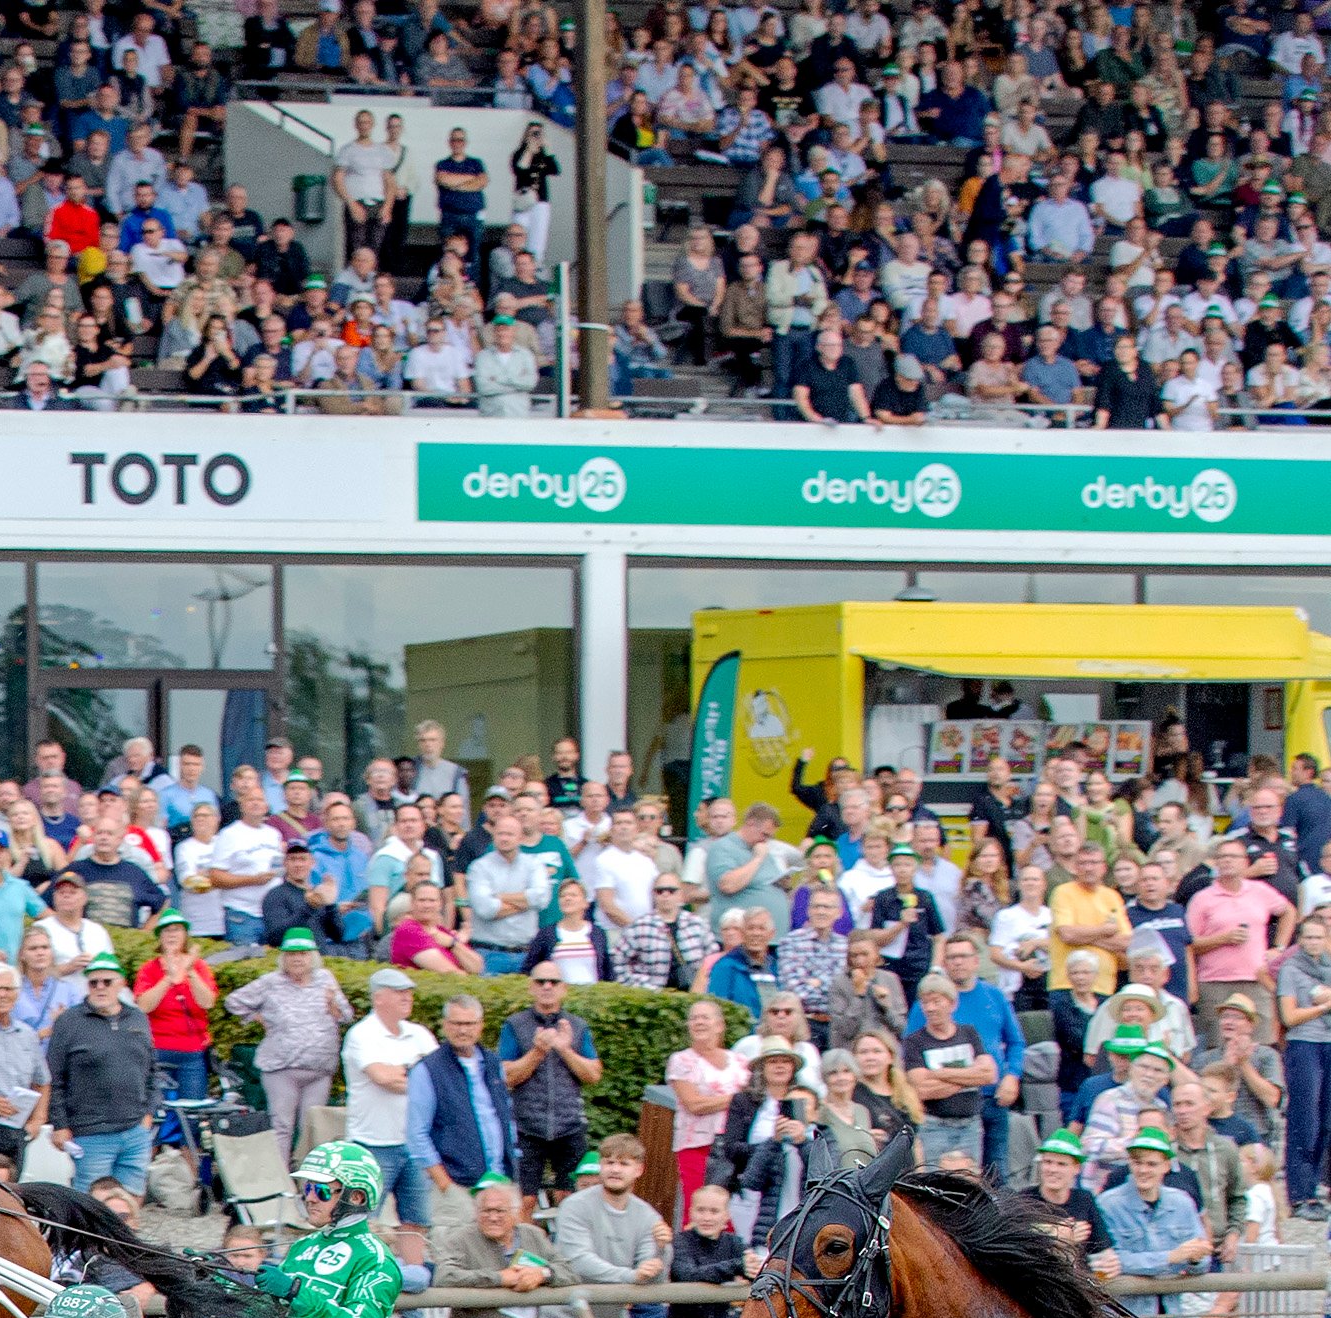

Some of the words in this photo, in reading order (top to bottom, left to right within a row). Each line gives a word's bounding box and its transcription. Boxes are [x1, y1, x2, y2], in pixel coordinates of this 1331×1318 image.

[70, 452, 251, 507] TOTO
[319, 1251, 345, 1266] 25
[56, 1296, 91, 1310] 1887
